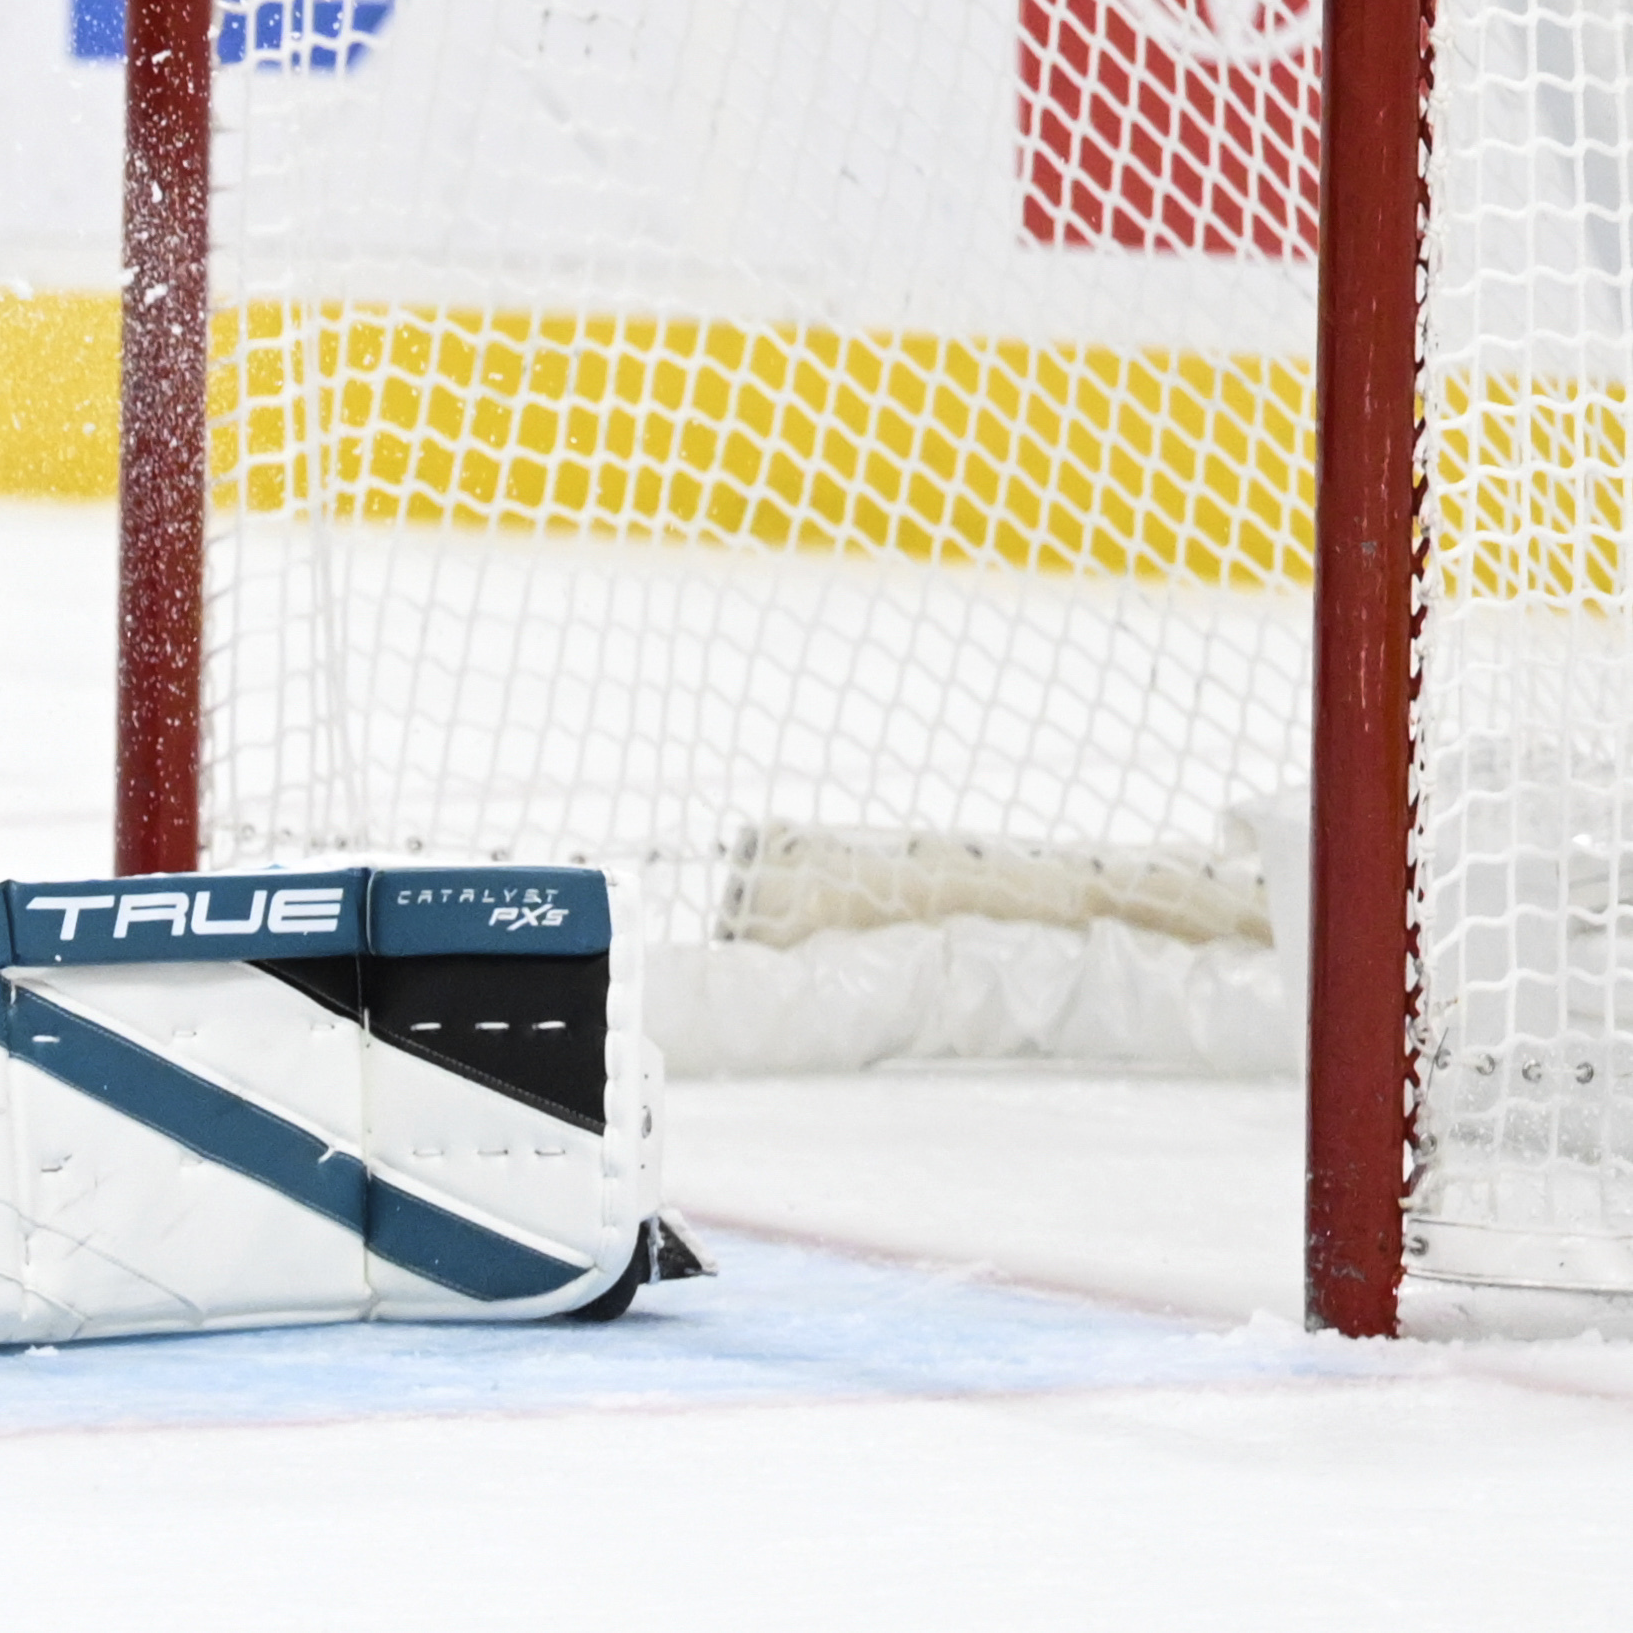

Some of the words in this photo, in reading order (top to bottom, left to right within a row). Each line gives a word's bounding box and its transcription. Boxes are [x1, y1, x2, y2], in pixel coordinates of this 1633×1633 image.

[397, 887, 563, 905] CATALYST
[26, 887, 345, 942] TRUE
[489, 902, 571, 932] PXS
